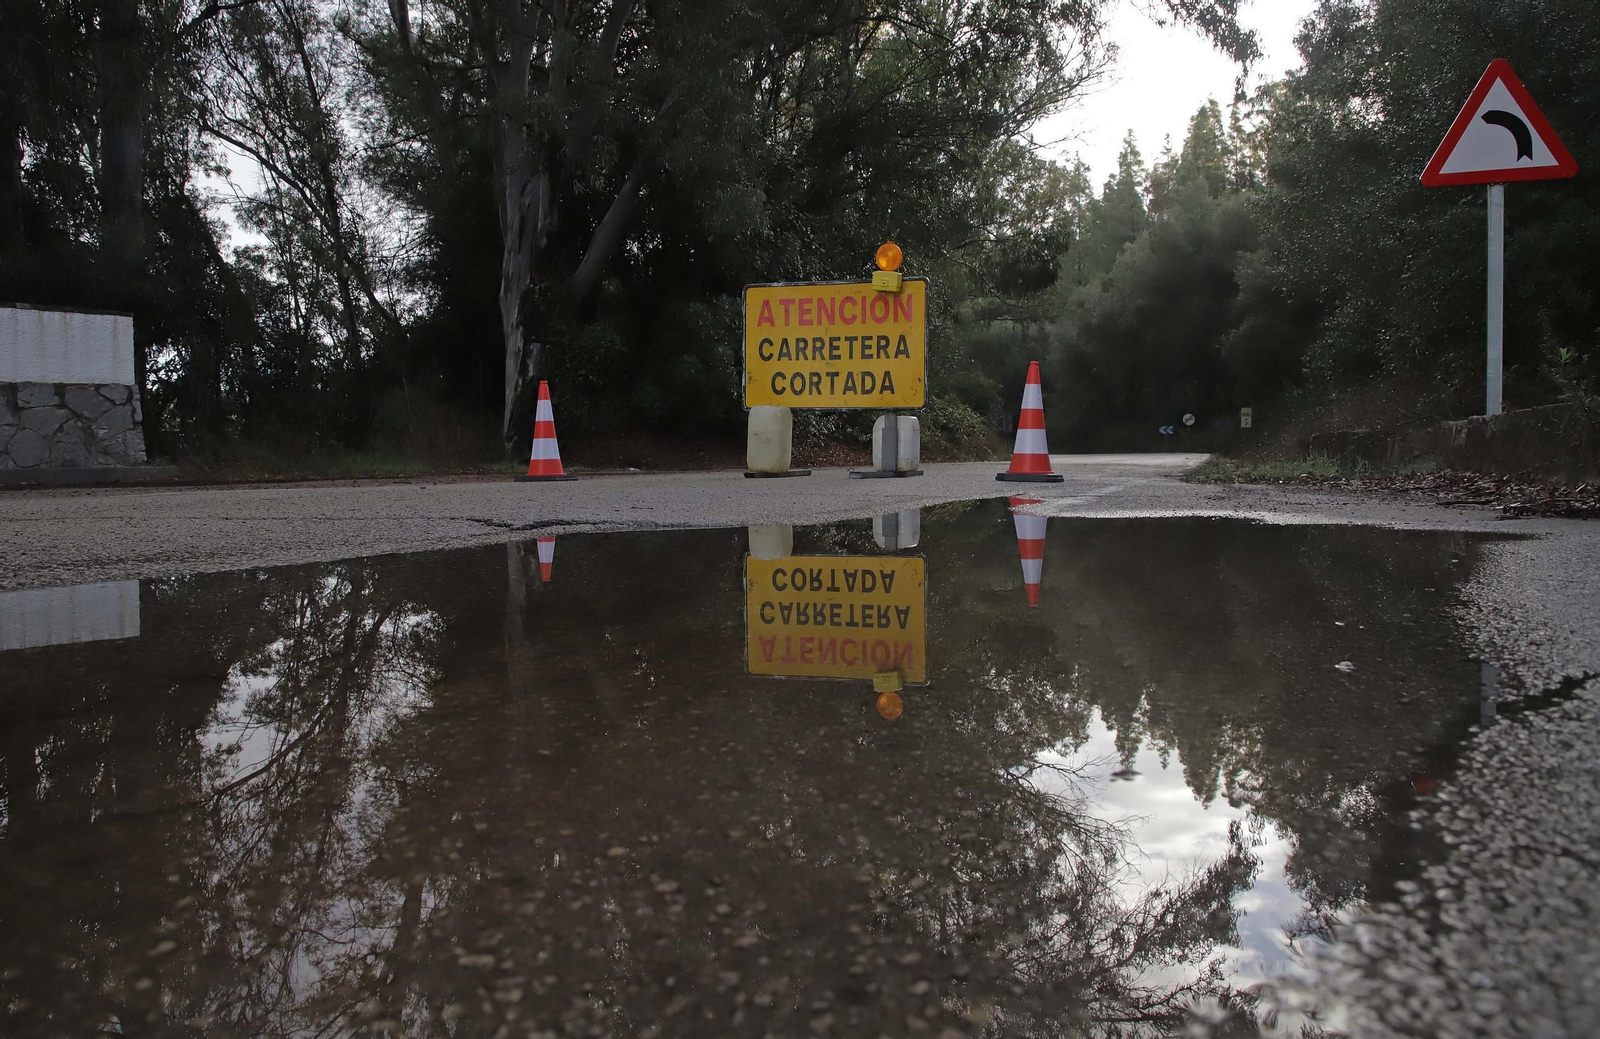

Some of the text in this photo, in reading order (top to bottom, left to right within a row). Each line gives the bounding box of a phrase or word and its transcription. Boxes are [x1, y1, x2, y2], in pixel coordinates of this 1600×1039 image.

[757, 294, 913, 327] ATENCION
[758, 334, 911, 361] CARRETERA
[771, 370, 895, 395] CORTADA
